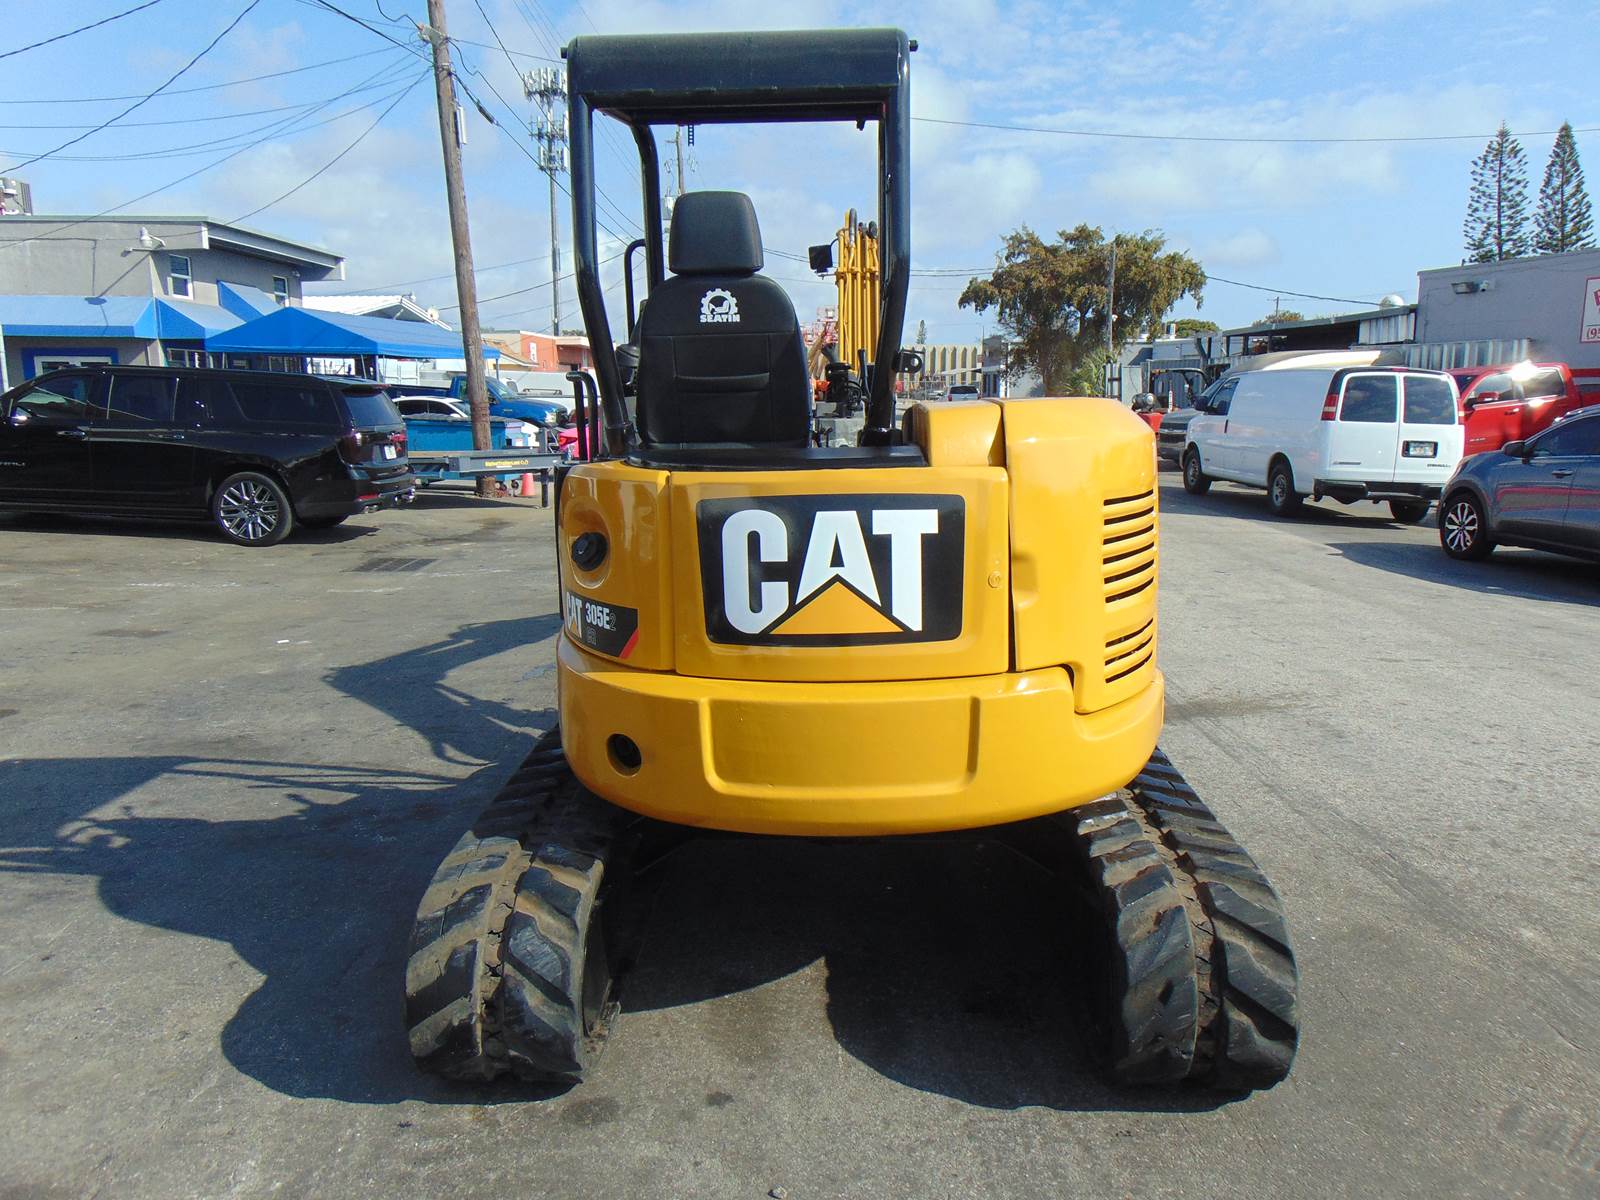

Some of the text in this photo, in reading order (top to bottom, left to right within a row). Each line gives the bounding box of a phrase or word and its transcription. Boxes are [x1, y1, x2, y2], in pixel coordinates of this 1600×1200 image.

[700, 314, 740, 323] SEATIN
[722, 509, 939, 634] CAT
[567, 592, 582, 639] CAT
